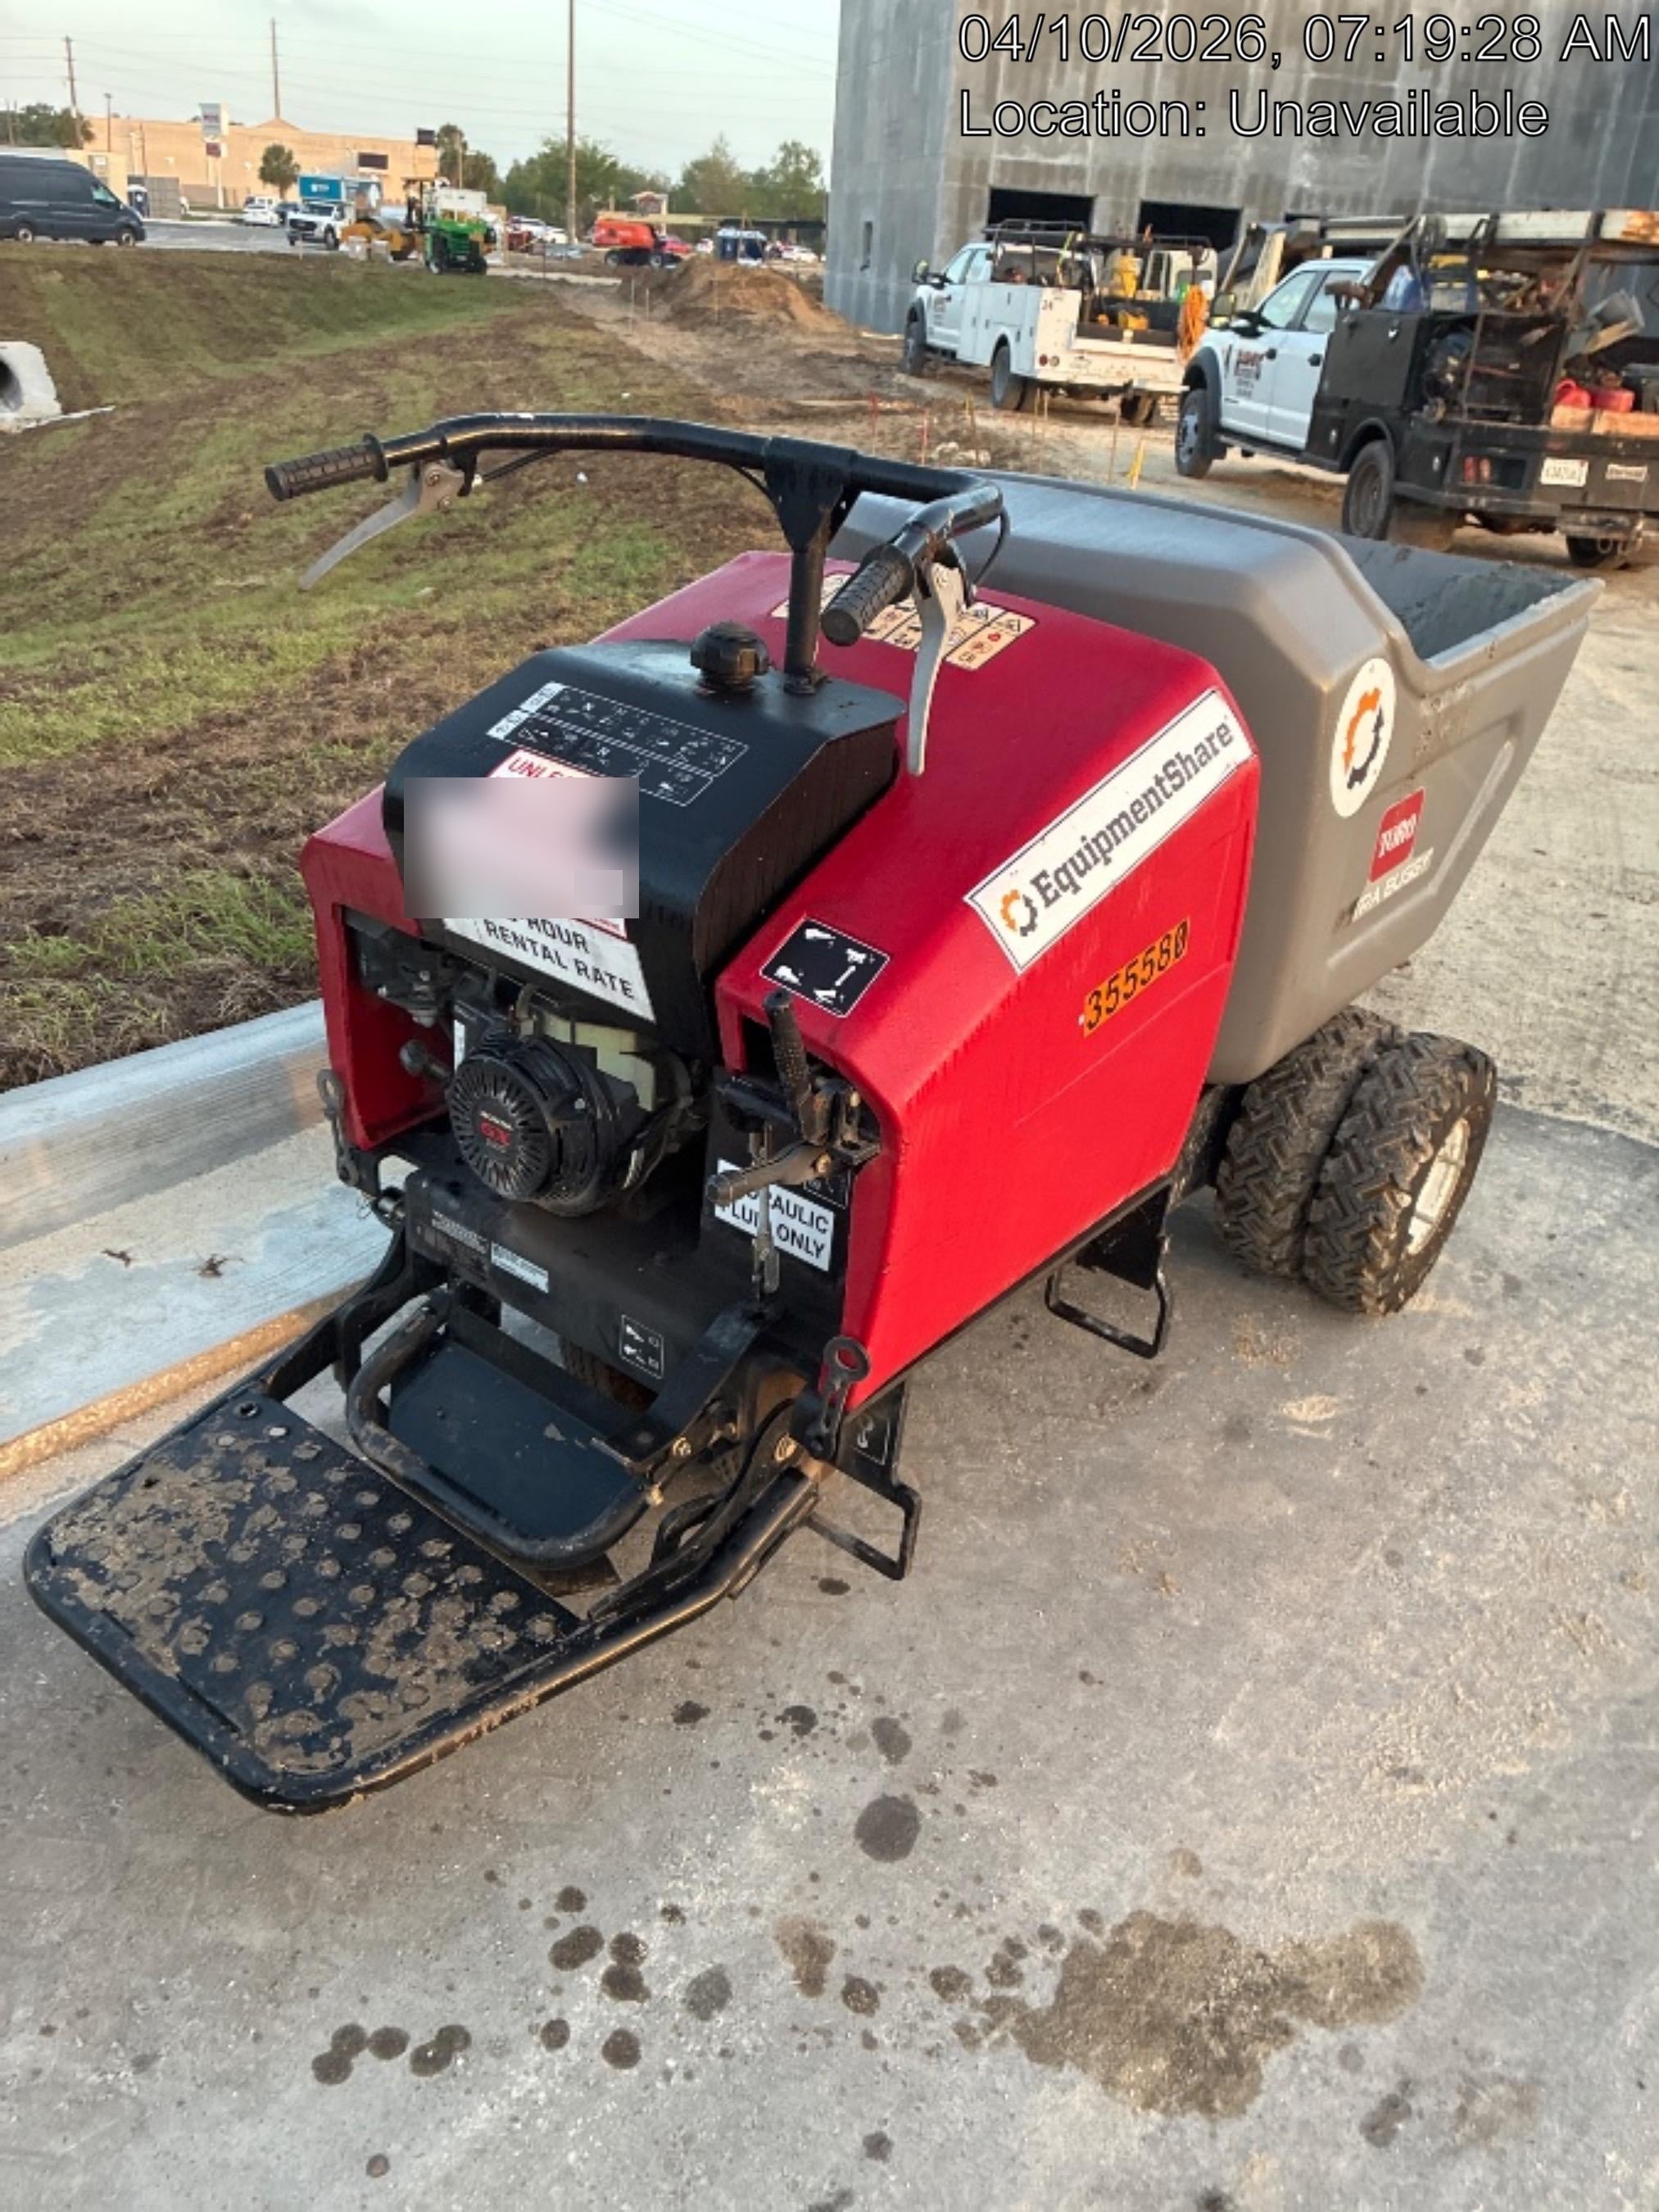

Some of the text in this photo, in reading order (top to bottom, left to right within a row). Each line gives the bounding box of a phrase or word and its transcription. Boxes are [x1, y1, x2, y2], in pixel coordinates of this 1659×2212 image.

[1031, 720, 1234, 905] EquipmentShare
[483, 919, 634, 999] RENTAL RATE
[1086, 920, 1190, 1030] 355580
[776, 1223, 826, 1259] ONLY
